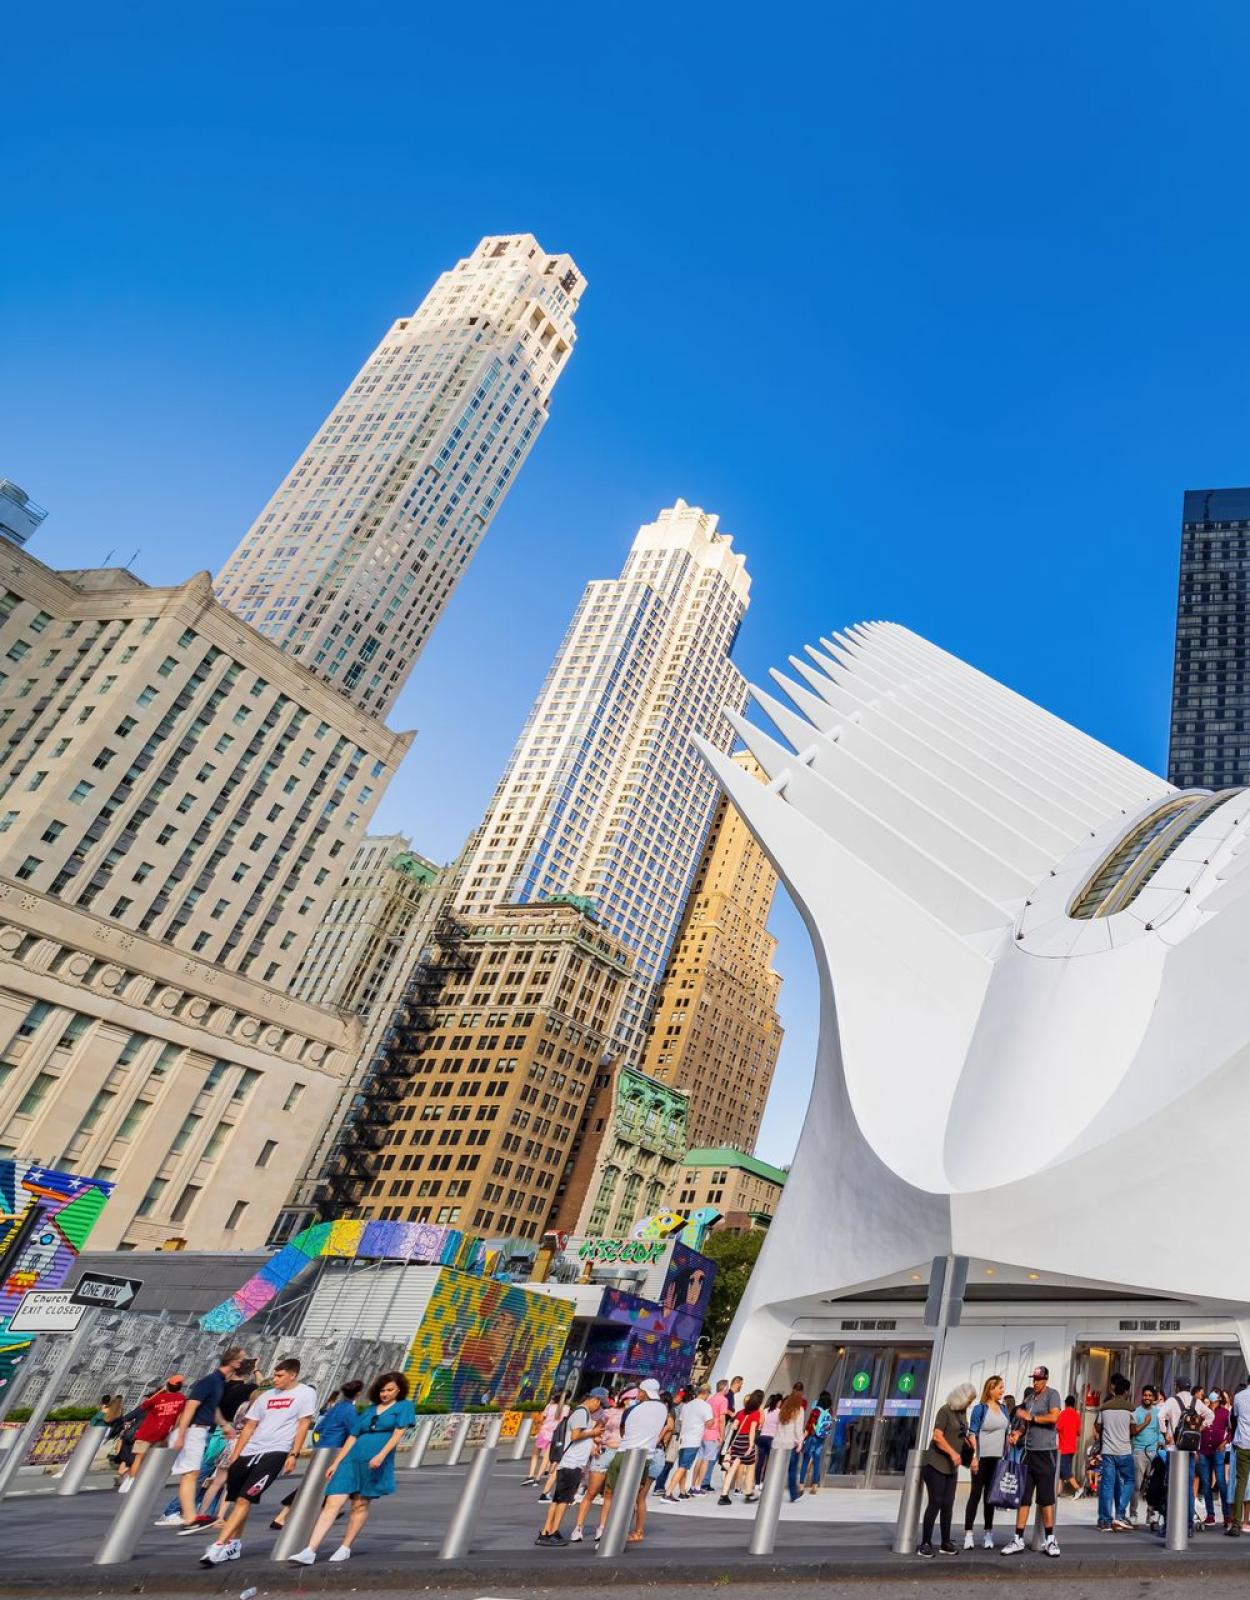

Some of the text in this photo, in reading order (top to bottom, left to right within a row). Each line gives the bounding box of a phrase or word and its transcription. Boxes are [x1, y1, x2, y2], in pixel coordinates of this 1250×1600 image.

[82, 1283, 122, 1299] ONE WAY
[33, 1294, 68, 1303] Church
[21, 1305, 82, 1315] EXIT CLOSED
[1120, 1320, 1181, 1330] WORLD TRADE CENTER
